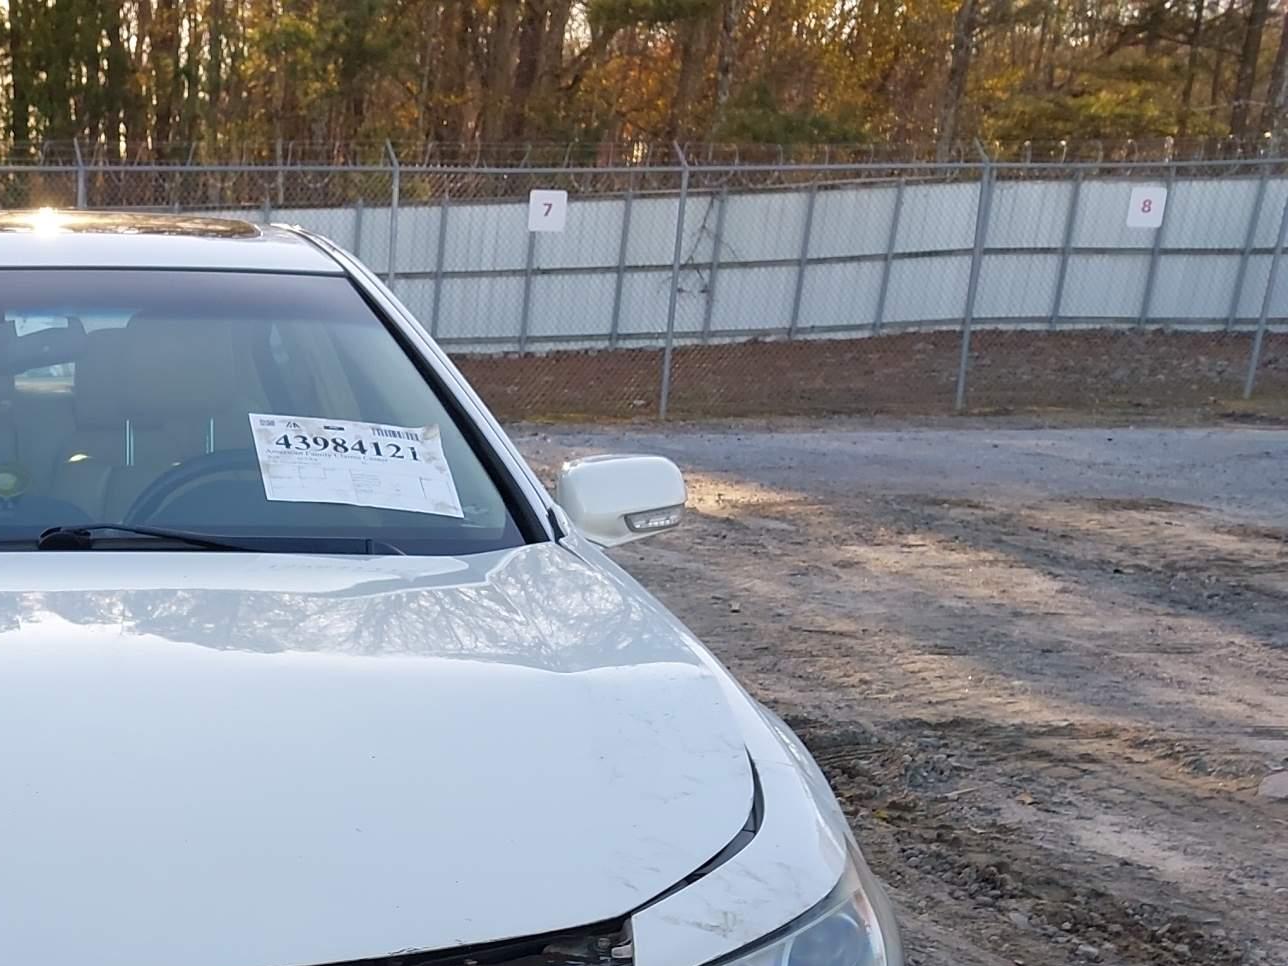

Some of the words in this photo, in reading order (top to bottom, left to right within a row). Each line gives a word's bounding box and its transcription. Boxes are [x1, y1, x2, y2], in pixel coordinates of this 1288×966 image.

[543, 203, 553, 217] 7
[1141, 199, 1153, 213] 8
[275, 434, 421, 461] 43984121
